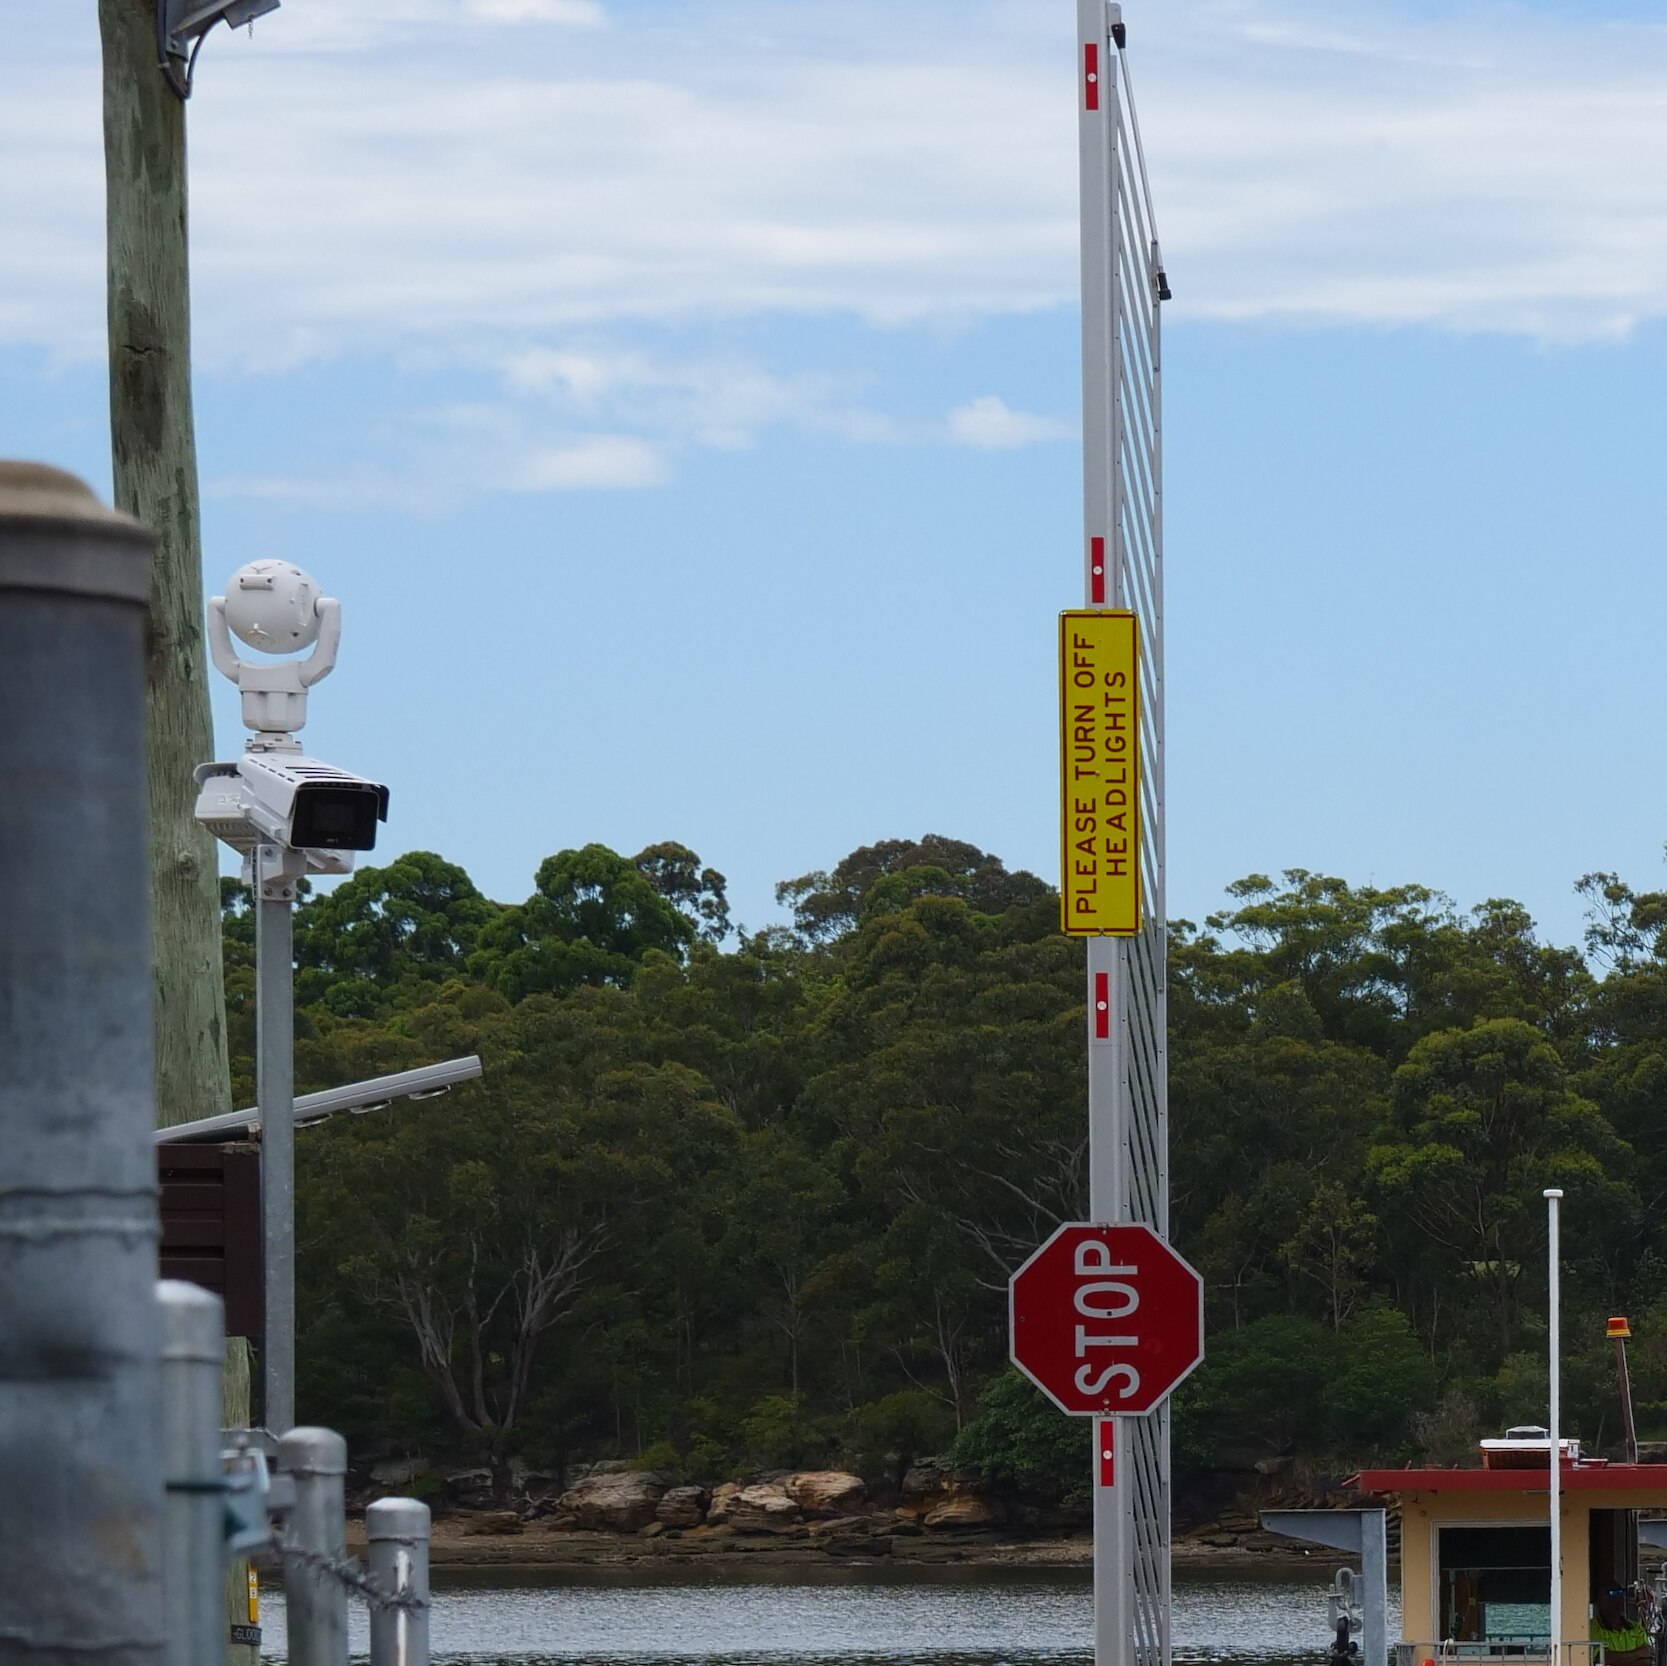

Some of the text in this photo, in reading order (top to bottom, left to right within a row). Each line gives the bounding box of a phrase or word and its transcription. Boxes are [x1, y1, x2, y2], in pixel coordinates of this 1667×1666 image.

[1073, 633, 1097, 914] PLEASE TURN OFF
[1104, 671, 1127, 876] HEADLIGHTS
[1073, 1240, 1141, 1399] STOP
